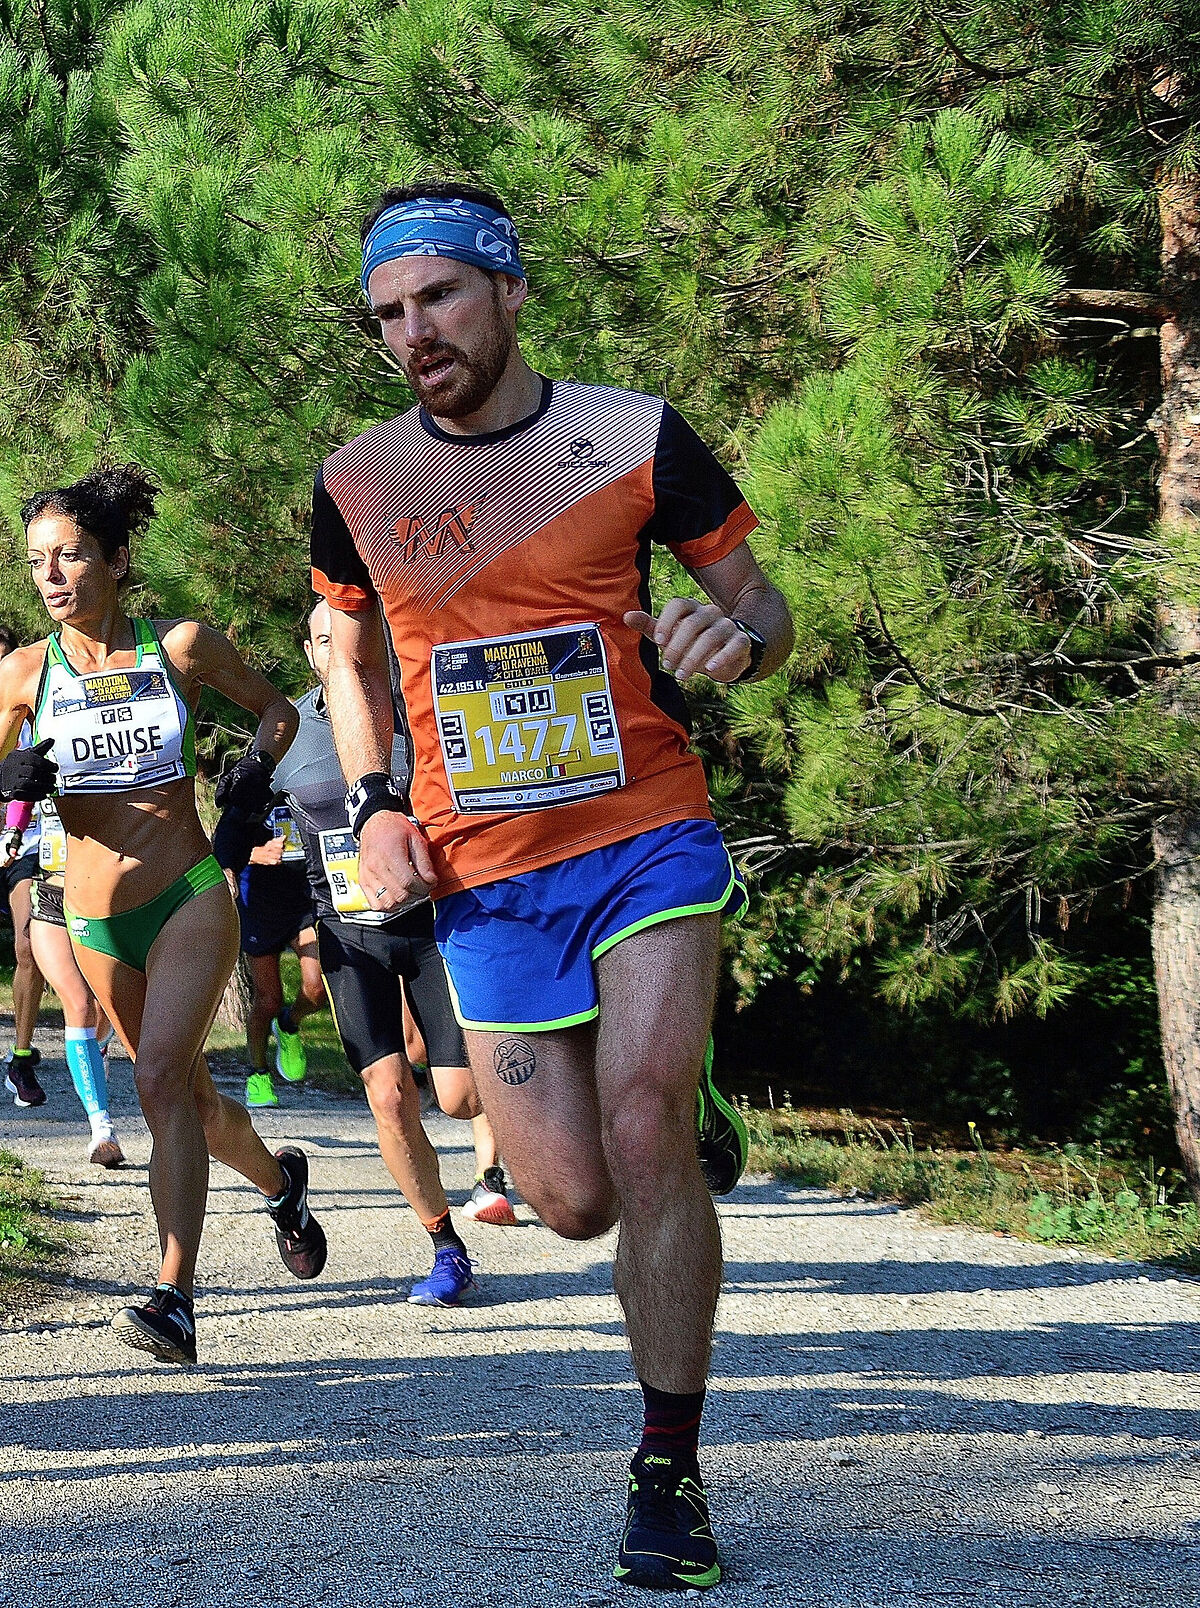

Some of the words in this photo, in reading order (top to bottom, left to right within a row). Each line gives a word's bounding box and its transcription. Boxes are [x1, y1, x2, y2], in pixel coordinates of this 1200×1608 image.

[483, 641, 545, 663] MARATONA
[501, 660, 511, 671] DI
[511, 655, 549, 670] RAVENNA
[85, 674, 130, 690] MARATONA
[439, 680, 474, 694] 42,195
[475, 679, 484, 690] K
[71, 725, 164, 763] DENISE
[474, 714, 578, 766] 1477
[500, 767, 545, 783] MARCO
[649, 1456, 672, 1465] asics
